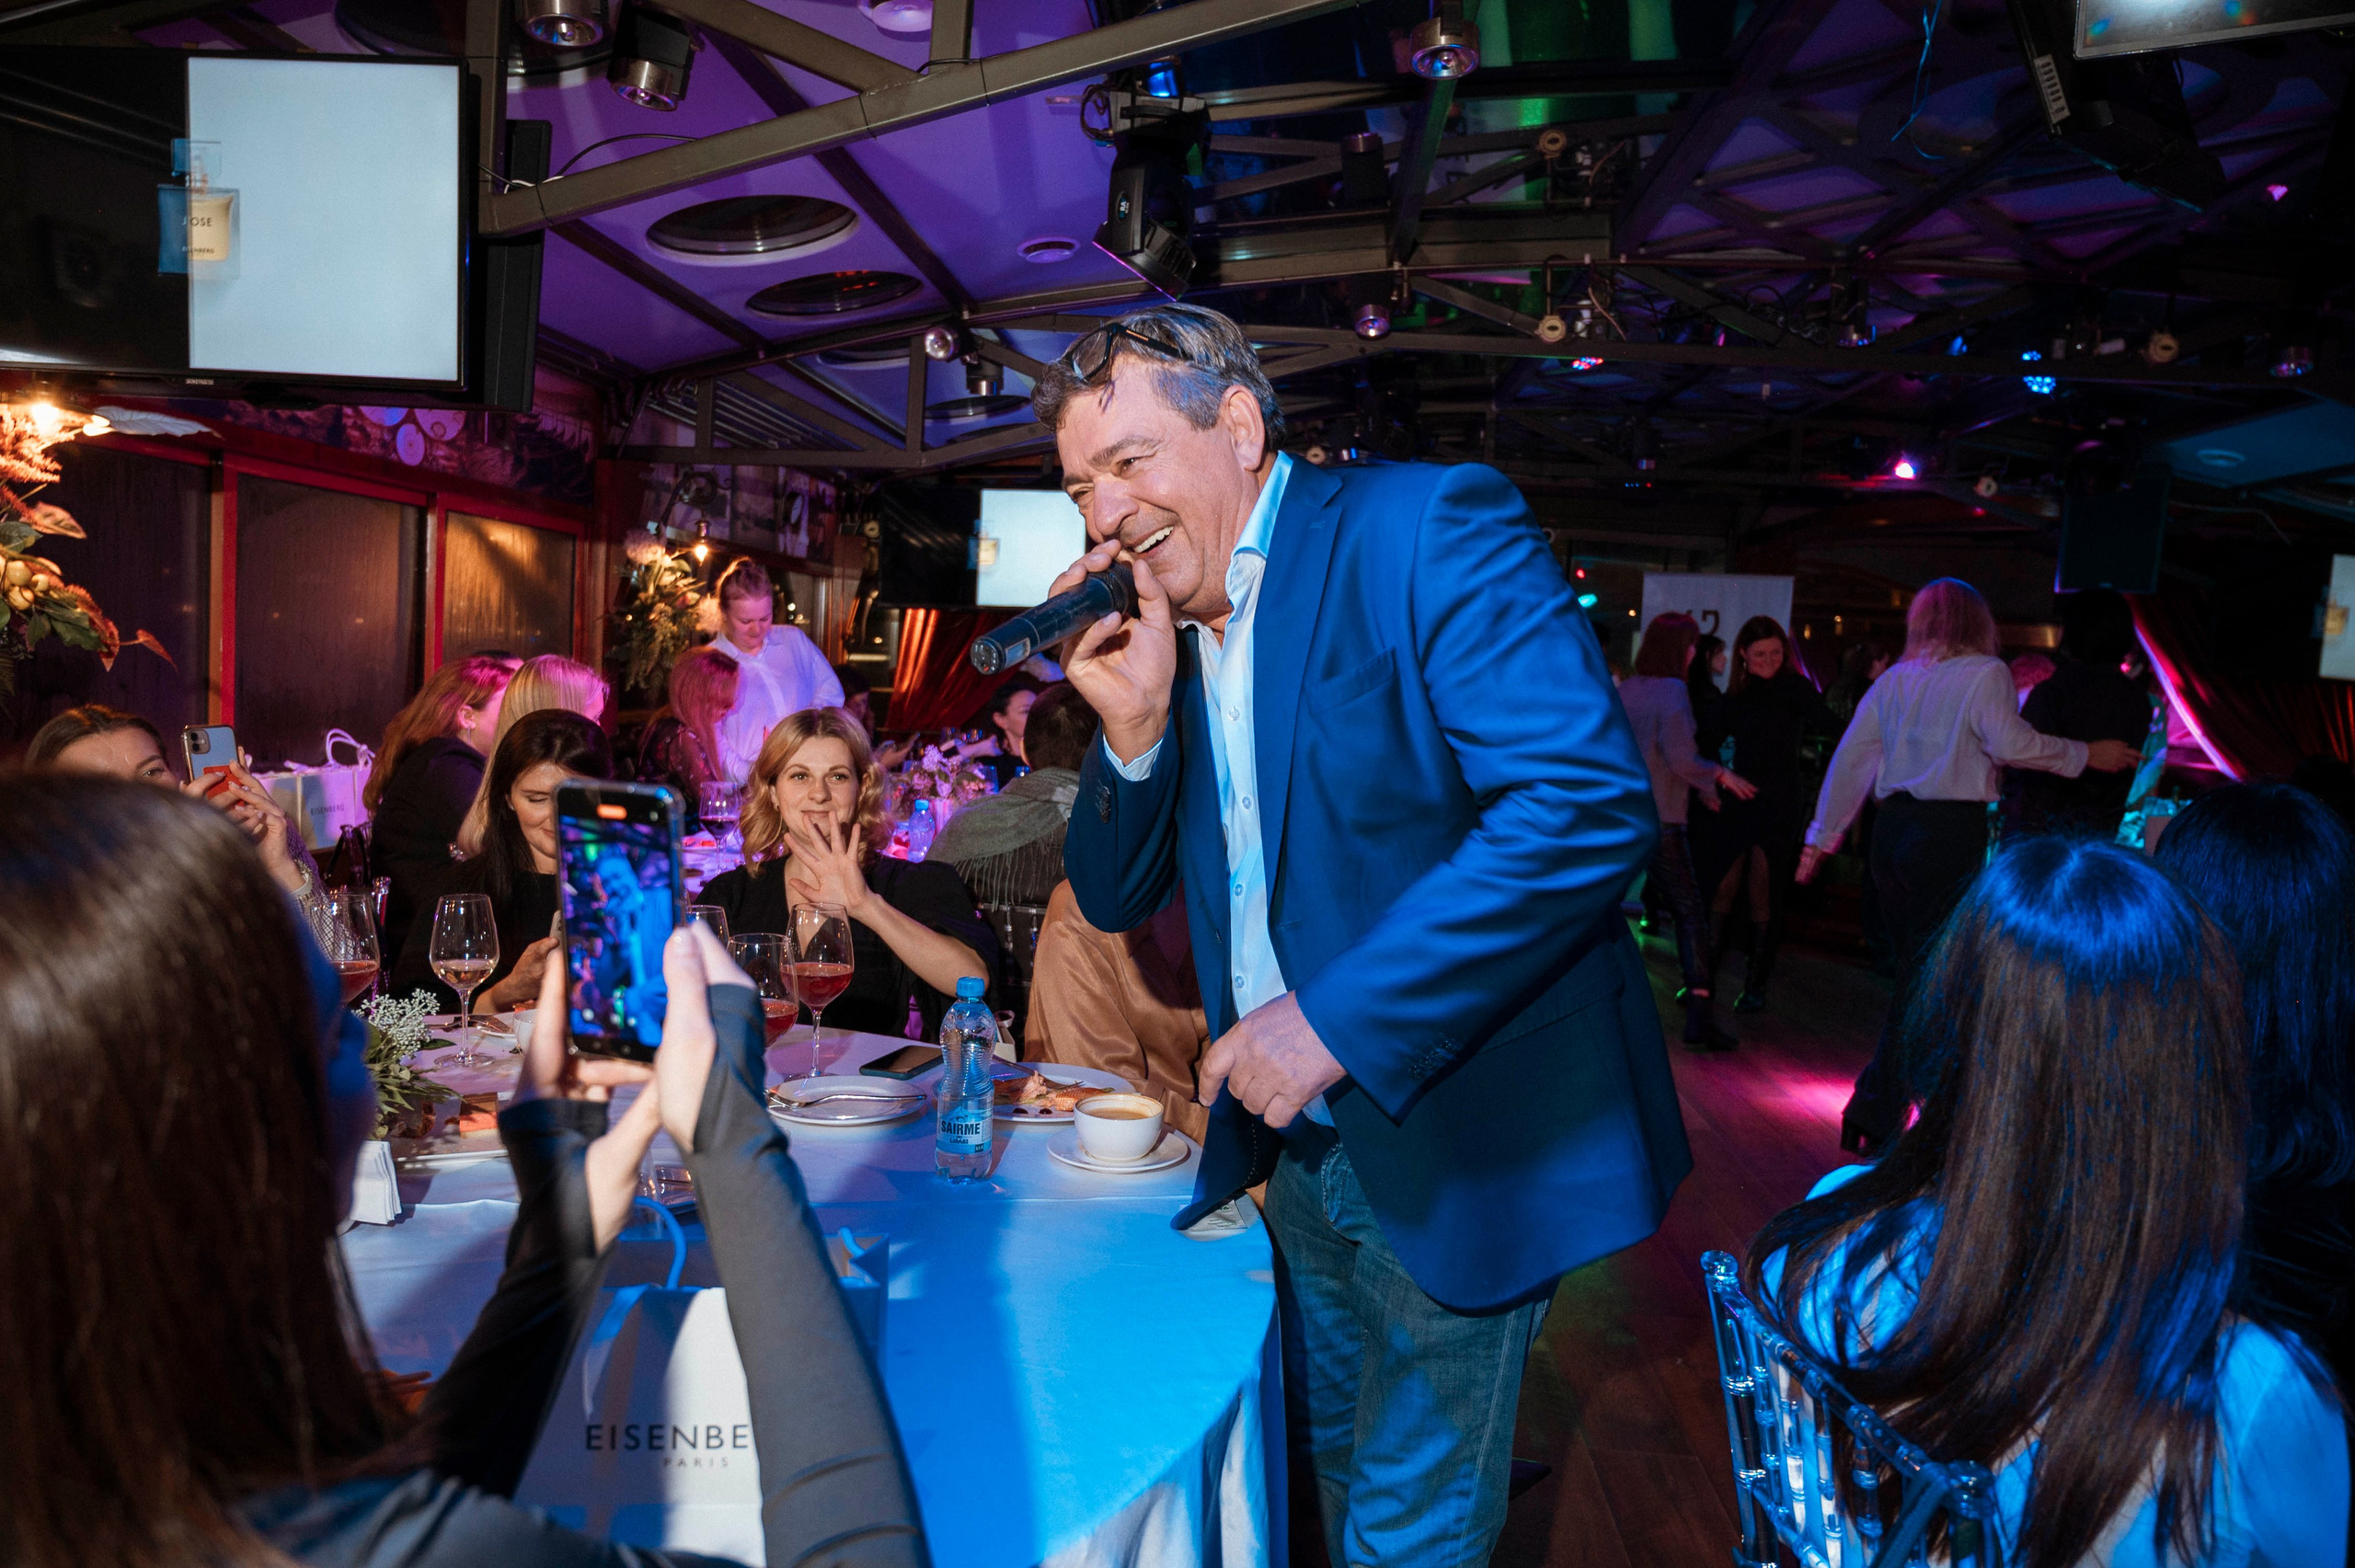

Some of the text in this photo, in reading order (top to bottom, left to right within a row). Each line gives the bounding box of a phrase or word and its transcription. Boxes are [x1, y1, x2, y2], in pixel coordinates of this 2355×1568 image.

[941, 1120, 981, 1135] SAIRME
[586, 1424, 750, 1451] EISENBE
[663, 1457, 729, 1468] PARIS
